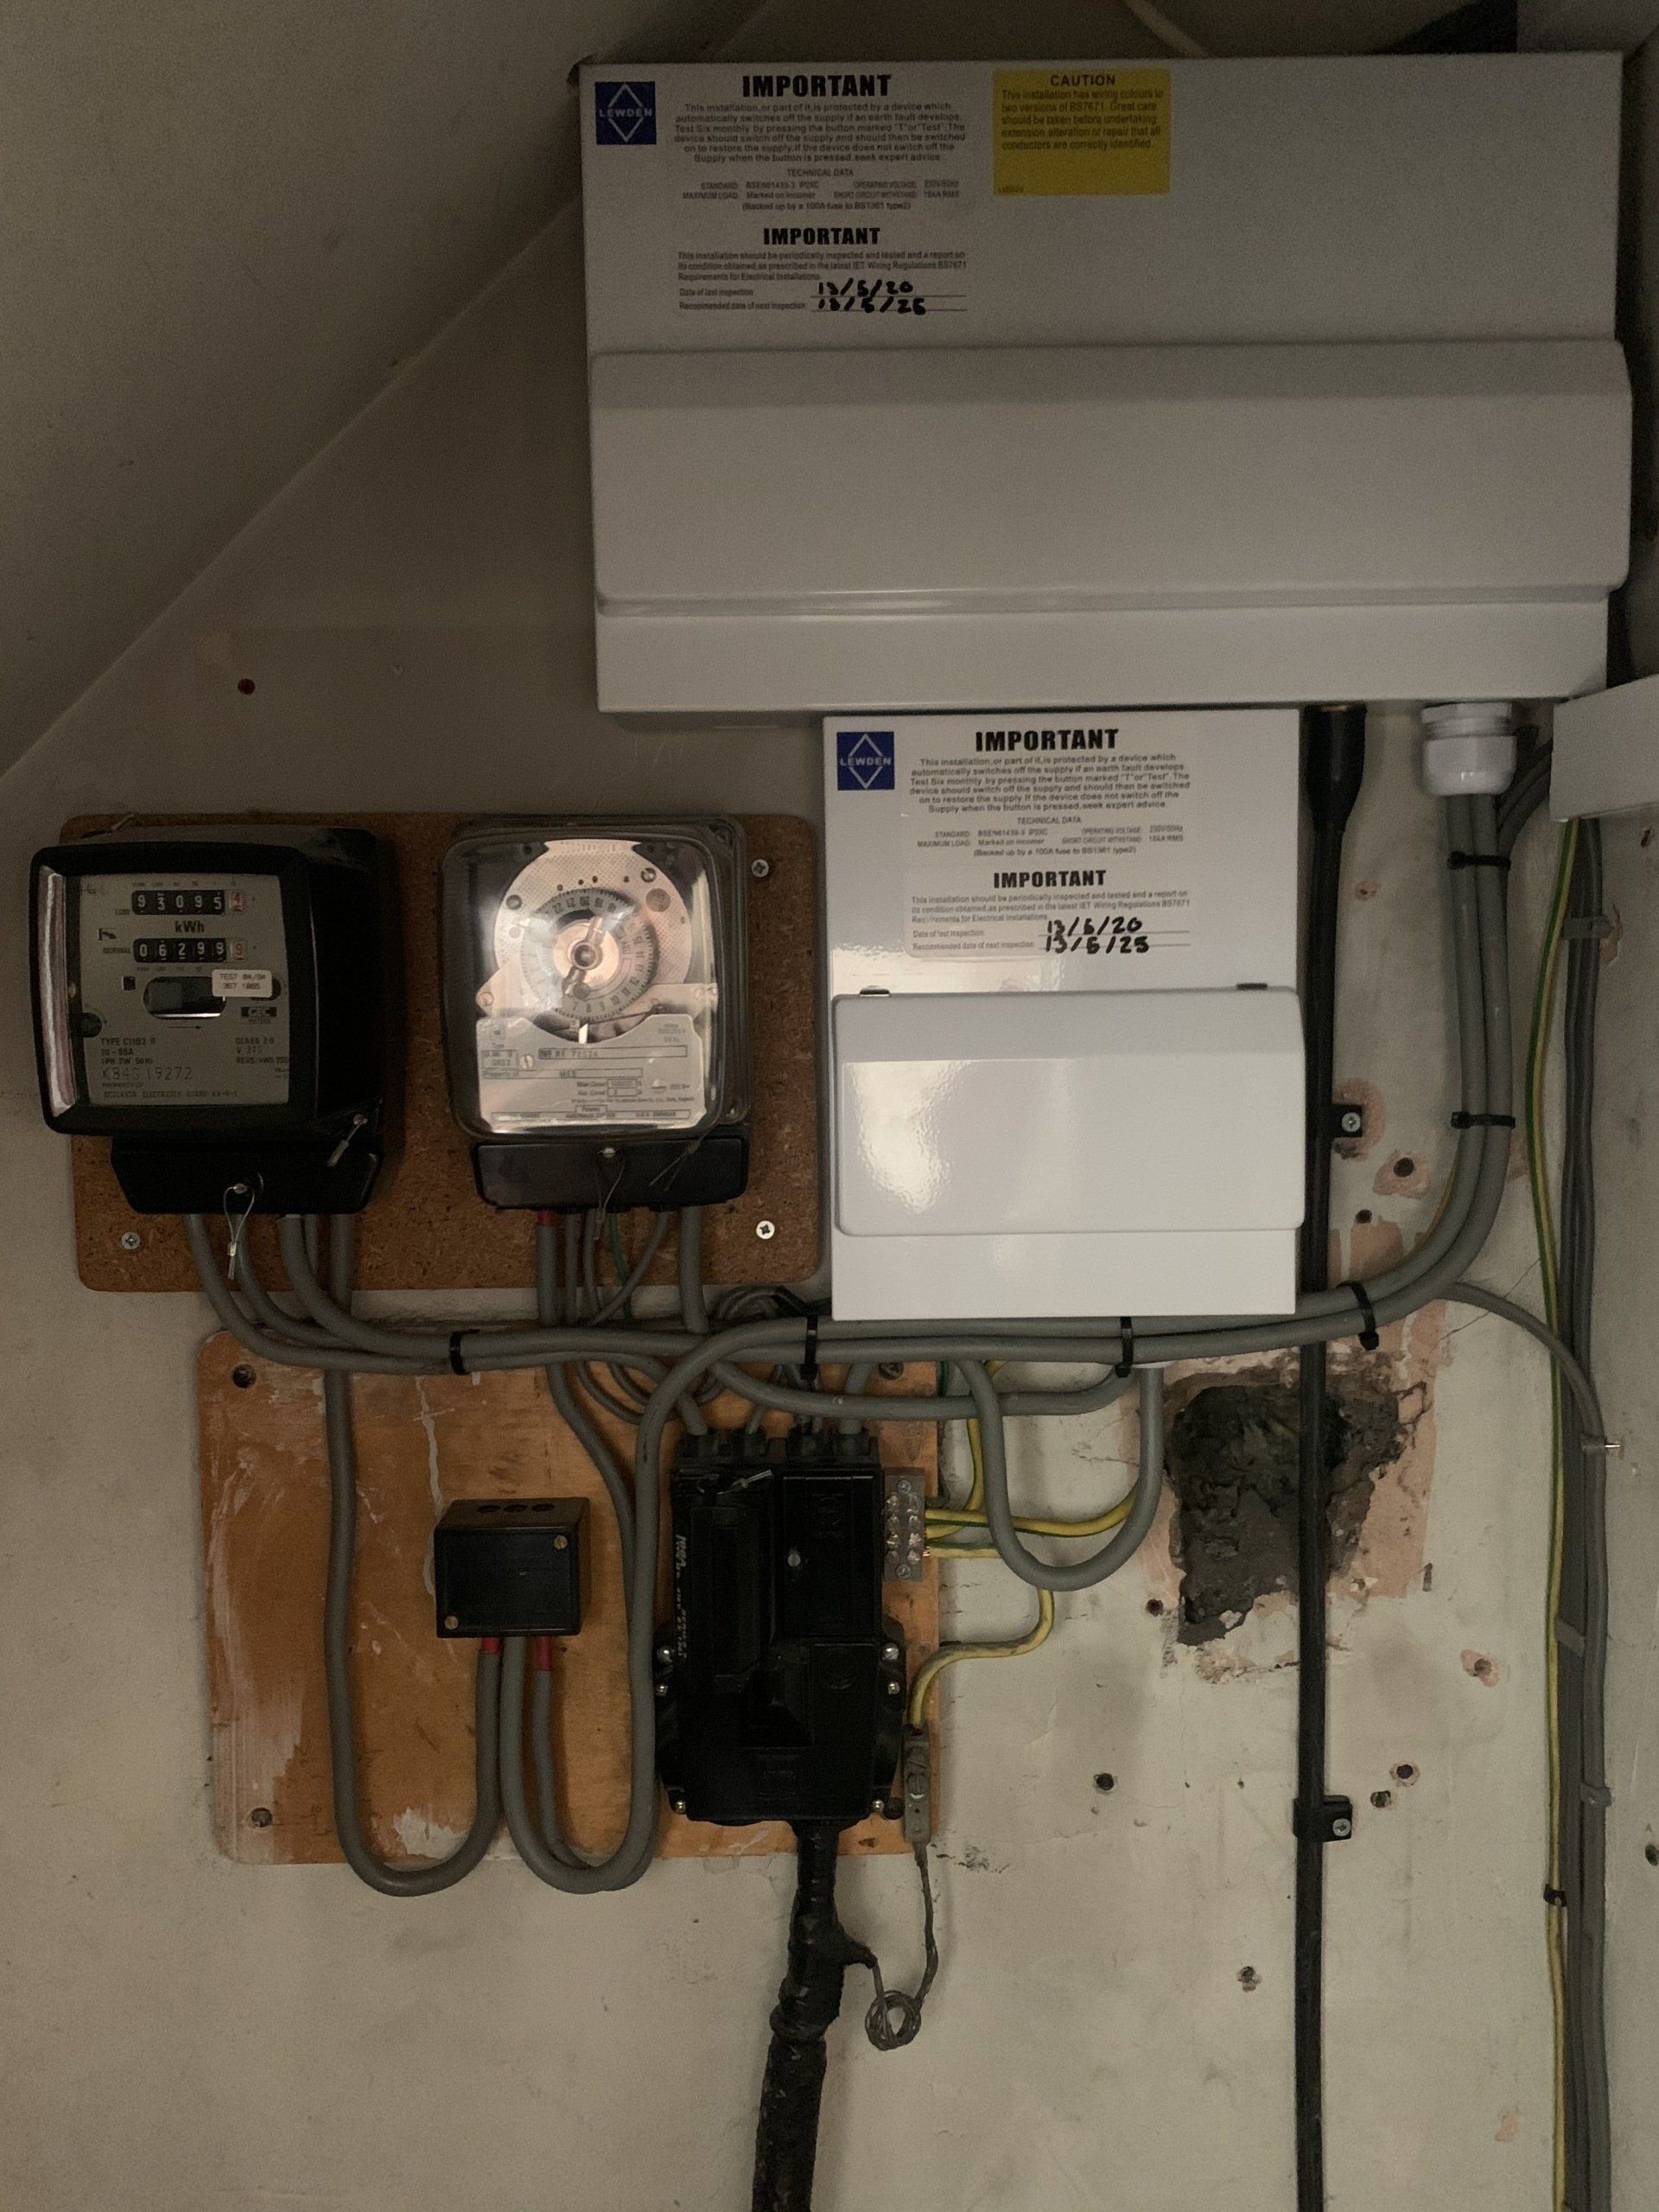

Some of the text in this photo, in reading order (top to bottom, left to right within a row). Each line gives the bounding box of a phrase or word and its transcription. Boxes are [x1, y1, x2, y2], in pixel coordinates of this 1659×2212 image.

[742, 74, 892, 98] IMPORTANT
[1050, 74, 1116, 86] CAUTION
[598, 108, 653, 118] LEWDEN
[1109, 102, 1135, 111] Great
[676, 114, 738, 124] automatically
[740, 113, 781, 123] switches
[782, 113, 795, 122] off
[797, 113, 811, 122] the
[814, 113, 845, 124] supply
[846, 113, 853, 122] if
[868, 113, 893, 122] earth
[894, 113, 916, 122] fault
[674, 133, 966, 143] device should switch off the supply and should then be switched
[764, 227, 880, 245] IMPORTANT
[975, 728, 1120, 752] IMPORTANT
[839, 756, 891, 766] LEWDEN
[920, 758, 939, 766] This
[1003, 756, 1022, 766] part
[1024, 756, 1033, 765] of
[1042, 755, 1051, 765] is
[1052, 755, 1096, 766] protected
[1097, 754, 1109, 765] by
[1118, 754, 1147, 763] device
[1149, 753, 1176, 762] which
[912, 766, 970, 778] automatically
[972, 766, 1012, 775] switches
[1014, 766, 1026, 774] off
[1027, 766, 1041, 774] the
[1043, 765, 1073, 775] supply
[1075, 765, 1082, 773] if
[1096, 764, 1120, 772] earth
[1121, 764, 1141, 772] fault
[910, 777, 929, 785] Test
[930, 776, 944, 785] Six
[946, 776, 982, 786] monthly
[984, 775, 995, 785] by
[997, 774, 1037, 785] pressing
[1038, 774, 1052, 783] the
[1054, 773, 1083, 783] button
[1084, 773, 1119, 782] marked
[1173, 772, 1190, 781] The
[910, 781, 1191, 794] device should switch off the supply and should then be switched
[931, 794, 941, 804] to
[942, 794, 975, 803] restore
[976, 793, 990, 803] the
[1024, 792, 1031, 802] If
[1032, 792, 1046, 801] the
[1048, 791, 1078, 801] device
[1079, 791, 1103, 800] does
[1103, 791, 1118, 800] not
[1120, 791, 1149, 800] switch
[1150, 791, 1163, 799] off
[1164, 790, 1179, 799] the
[928, 804, 959, 815] Supply
[961, 804, 985, 812] when
[987, 803, 1001, 812] the
[1002, 803, 1031, 811] button
[1033, 802, 1041, 811] is
[1082, 801, 1103, 810] seek
[1105, 800, 1134, 810] expert
[994, 870, 1107, 889] IMPORTANT
[175, 919, 205, 933] kWh
